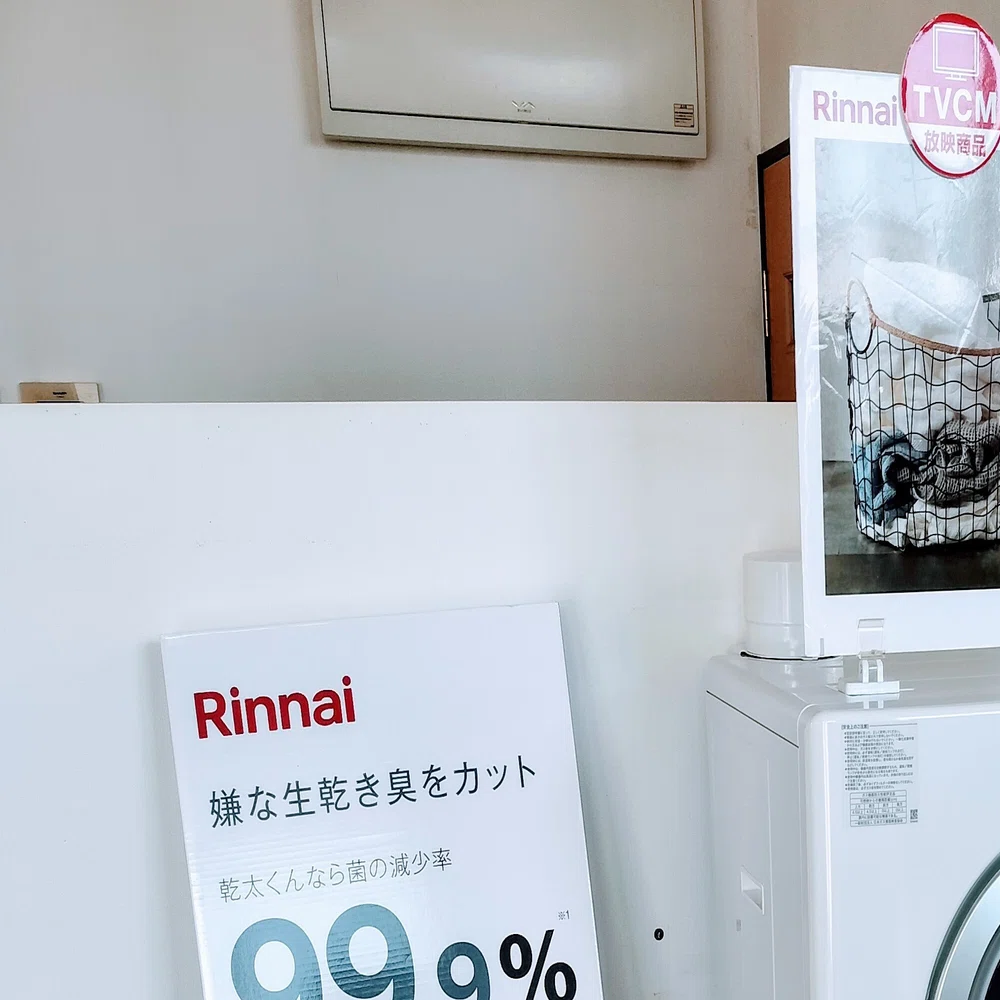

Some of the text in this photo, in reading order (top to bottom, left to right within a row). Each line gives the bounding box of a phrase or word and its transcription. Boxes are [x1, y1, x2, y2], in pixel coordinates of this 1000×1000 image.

[813, 91, 897, 127] Rinnai
[913, 84, 997, 124] TVCM
[924, 130, 986, 157] 放映商品
[193, 675, 356, 740] Rinnai
[209, 755, 537, 828] 嫌な生乾き臭をカット
[219, 848, 453, 903] 乾太くんなら菌の減少率
